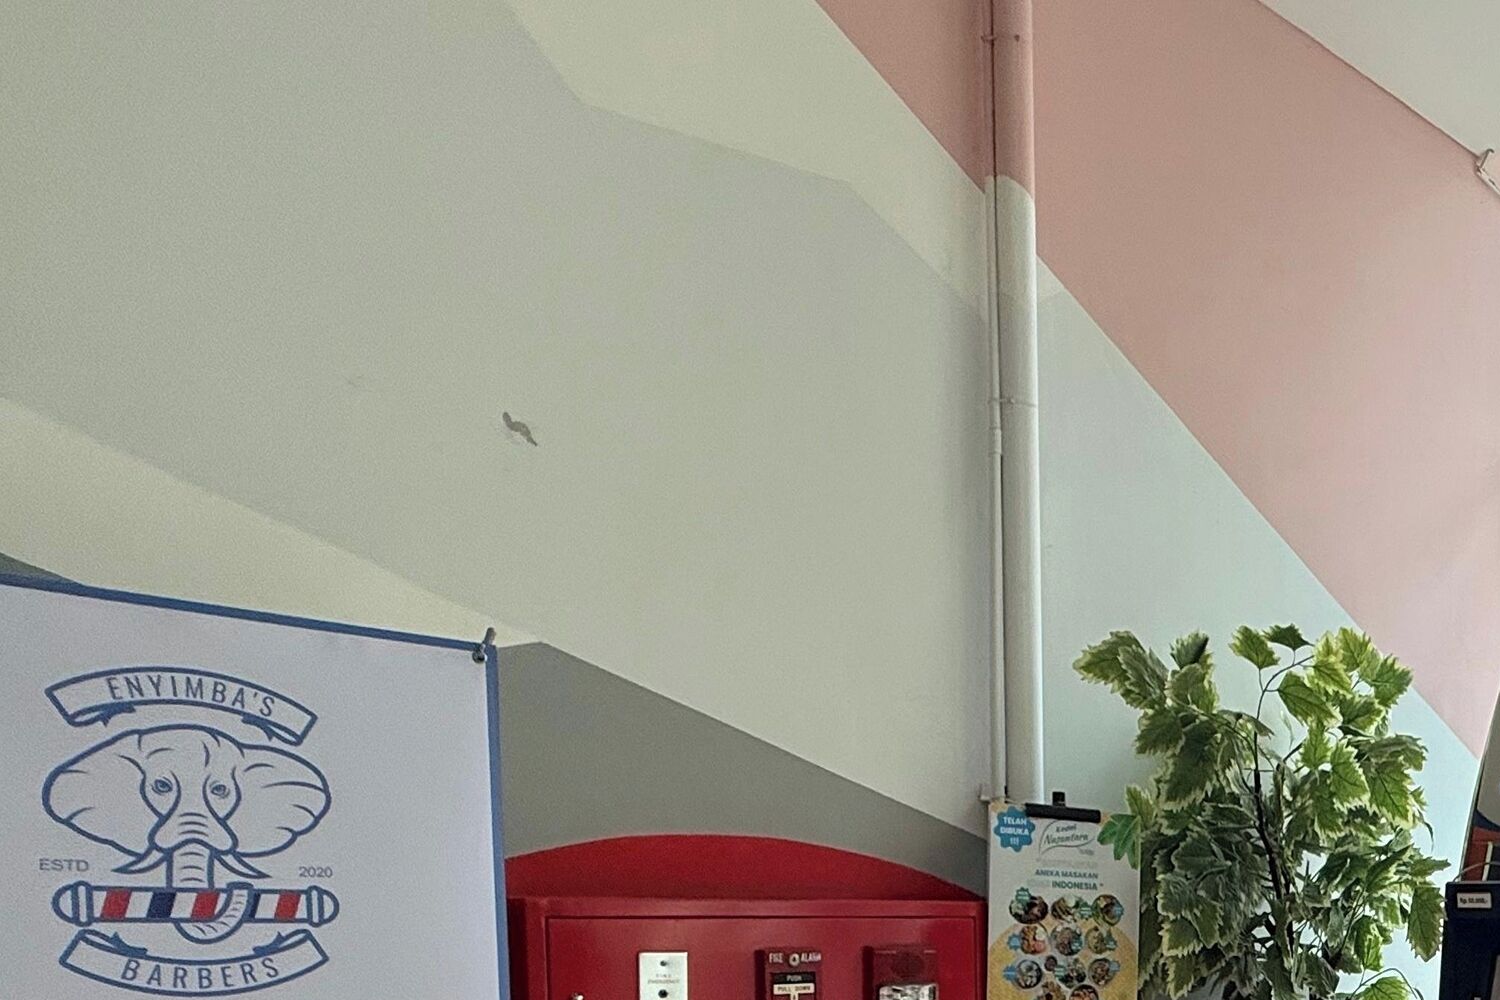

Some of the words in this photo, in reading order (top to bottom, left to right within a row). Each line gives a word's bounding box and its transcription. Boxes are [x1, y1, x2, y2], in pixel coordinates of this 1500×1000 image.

[107, 676, 276, 718] ENYIMBA'S
[1003, 817, 1027, 825] TELAH
[1000, 827, 1030, 835] DIBUKA
[39, 858, 89, 872] ESTD
[299, 866, 333, 878] 2020
[1061, 870, 1098, 879] MASAKAN
[1052, 881, 1098, 890] INDONESIA
[120, 957, 280, 990] BARBERS
